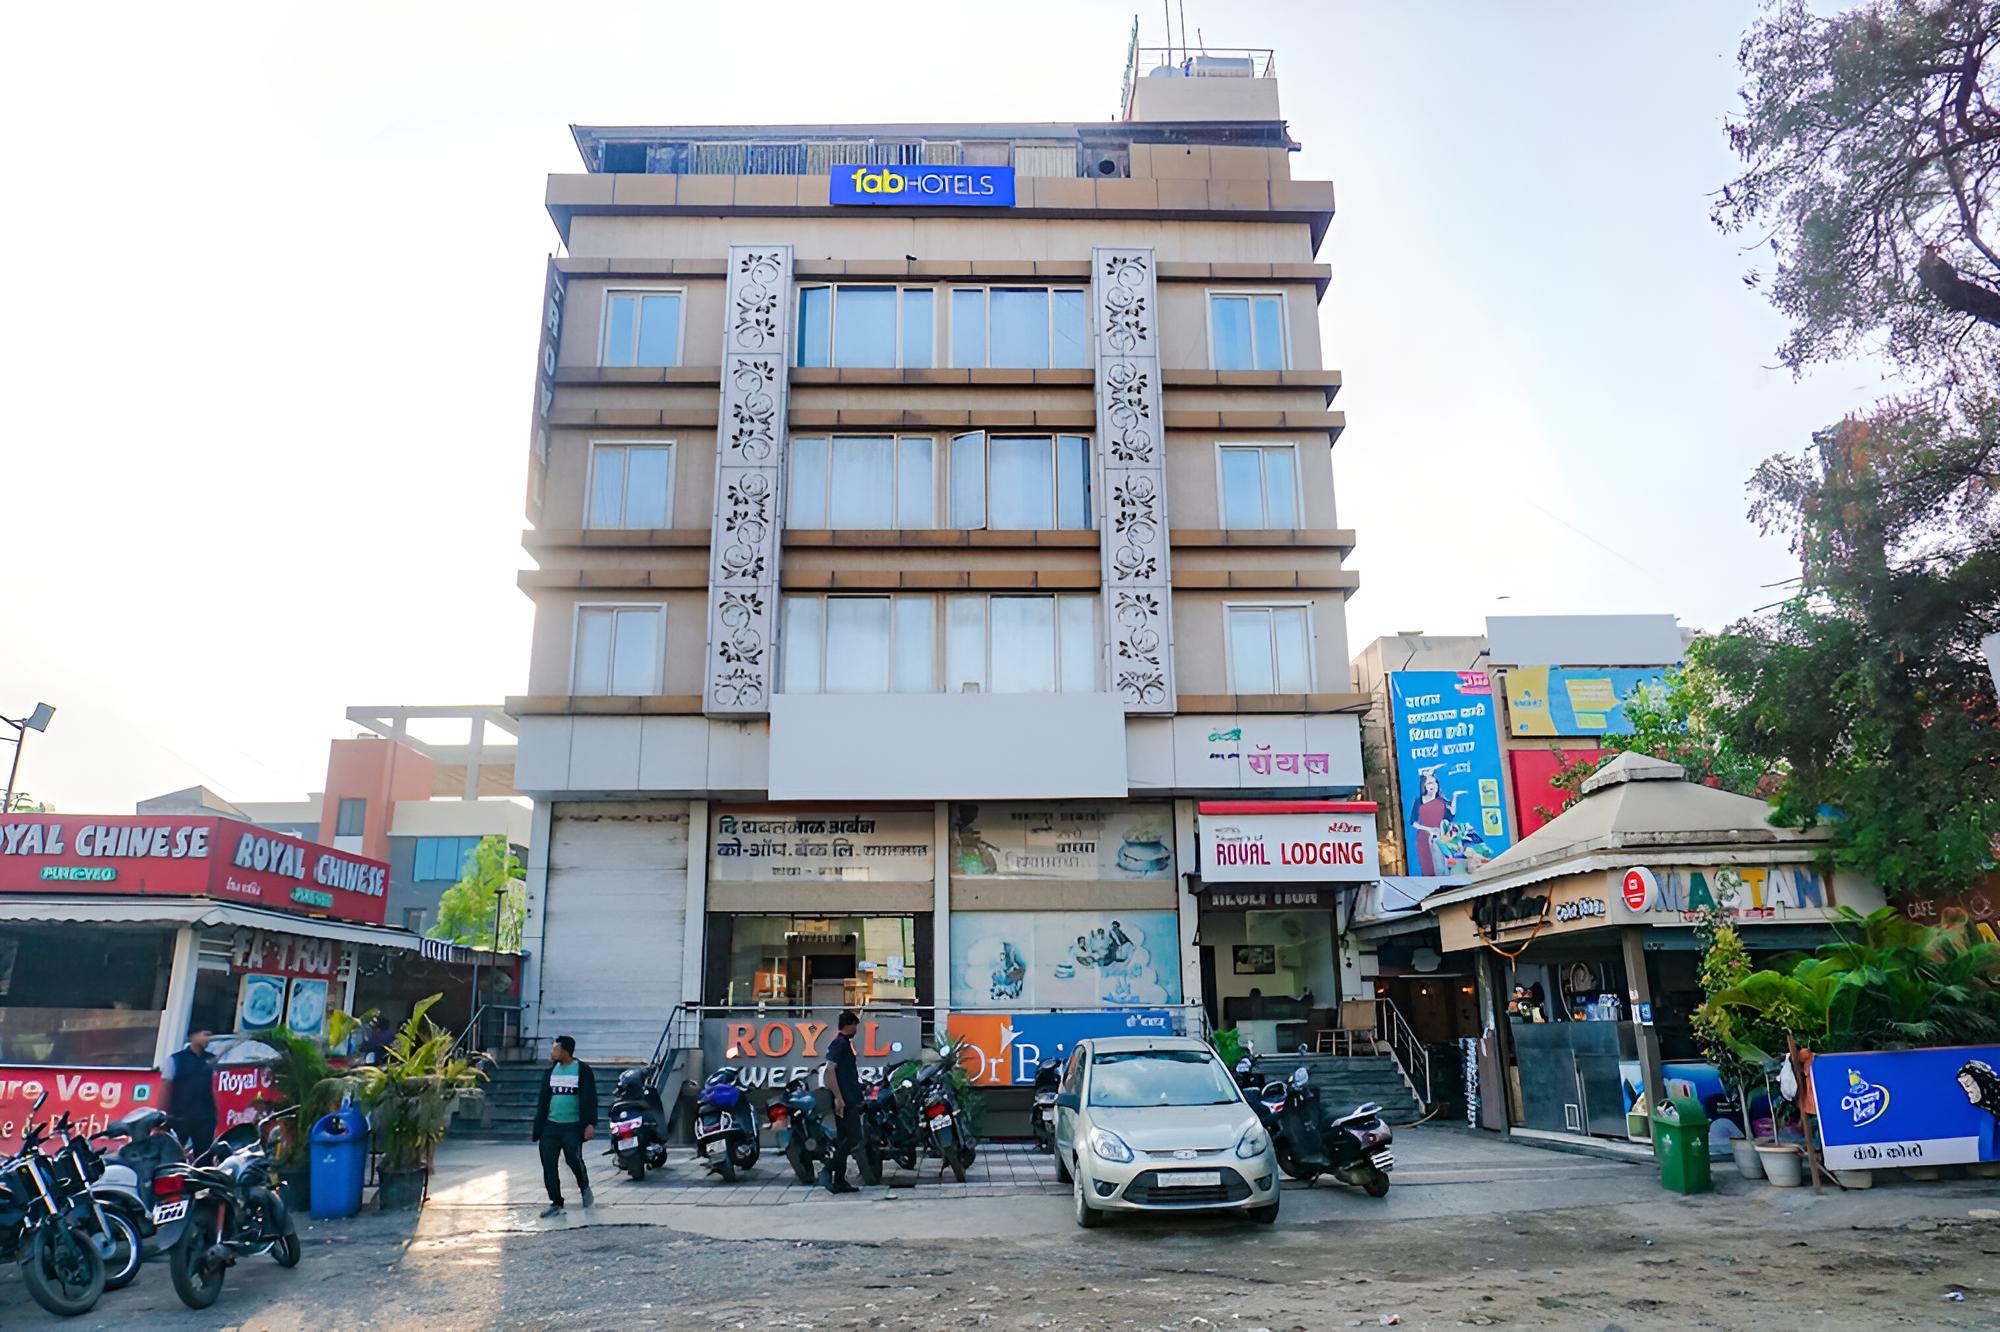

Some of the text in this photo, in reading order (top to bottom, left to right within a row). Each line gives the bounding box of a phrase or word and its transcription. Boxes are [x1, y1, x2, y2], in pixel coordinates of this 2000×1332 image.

[1247, 744, 1329, 775] रॉयल
[75, 824, 211, 859] CHINESE
[1281, 842, 1364, 865] LODGING
[234, 833, 306, 880] ROYAL
[314, 854, 386, 897] CHINESE
[726, 1020, 893, 1059] ROYL
[56, 1074, 122, 1109] Veg
[218, 1068, 258, 1096] Royal
